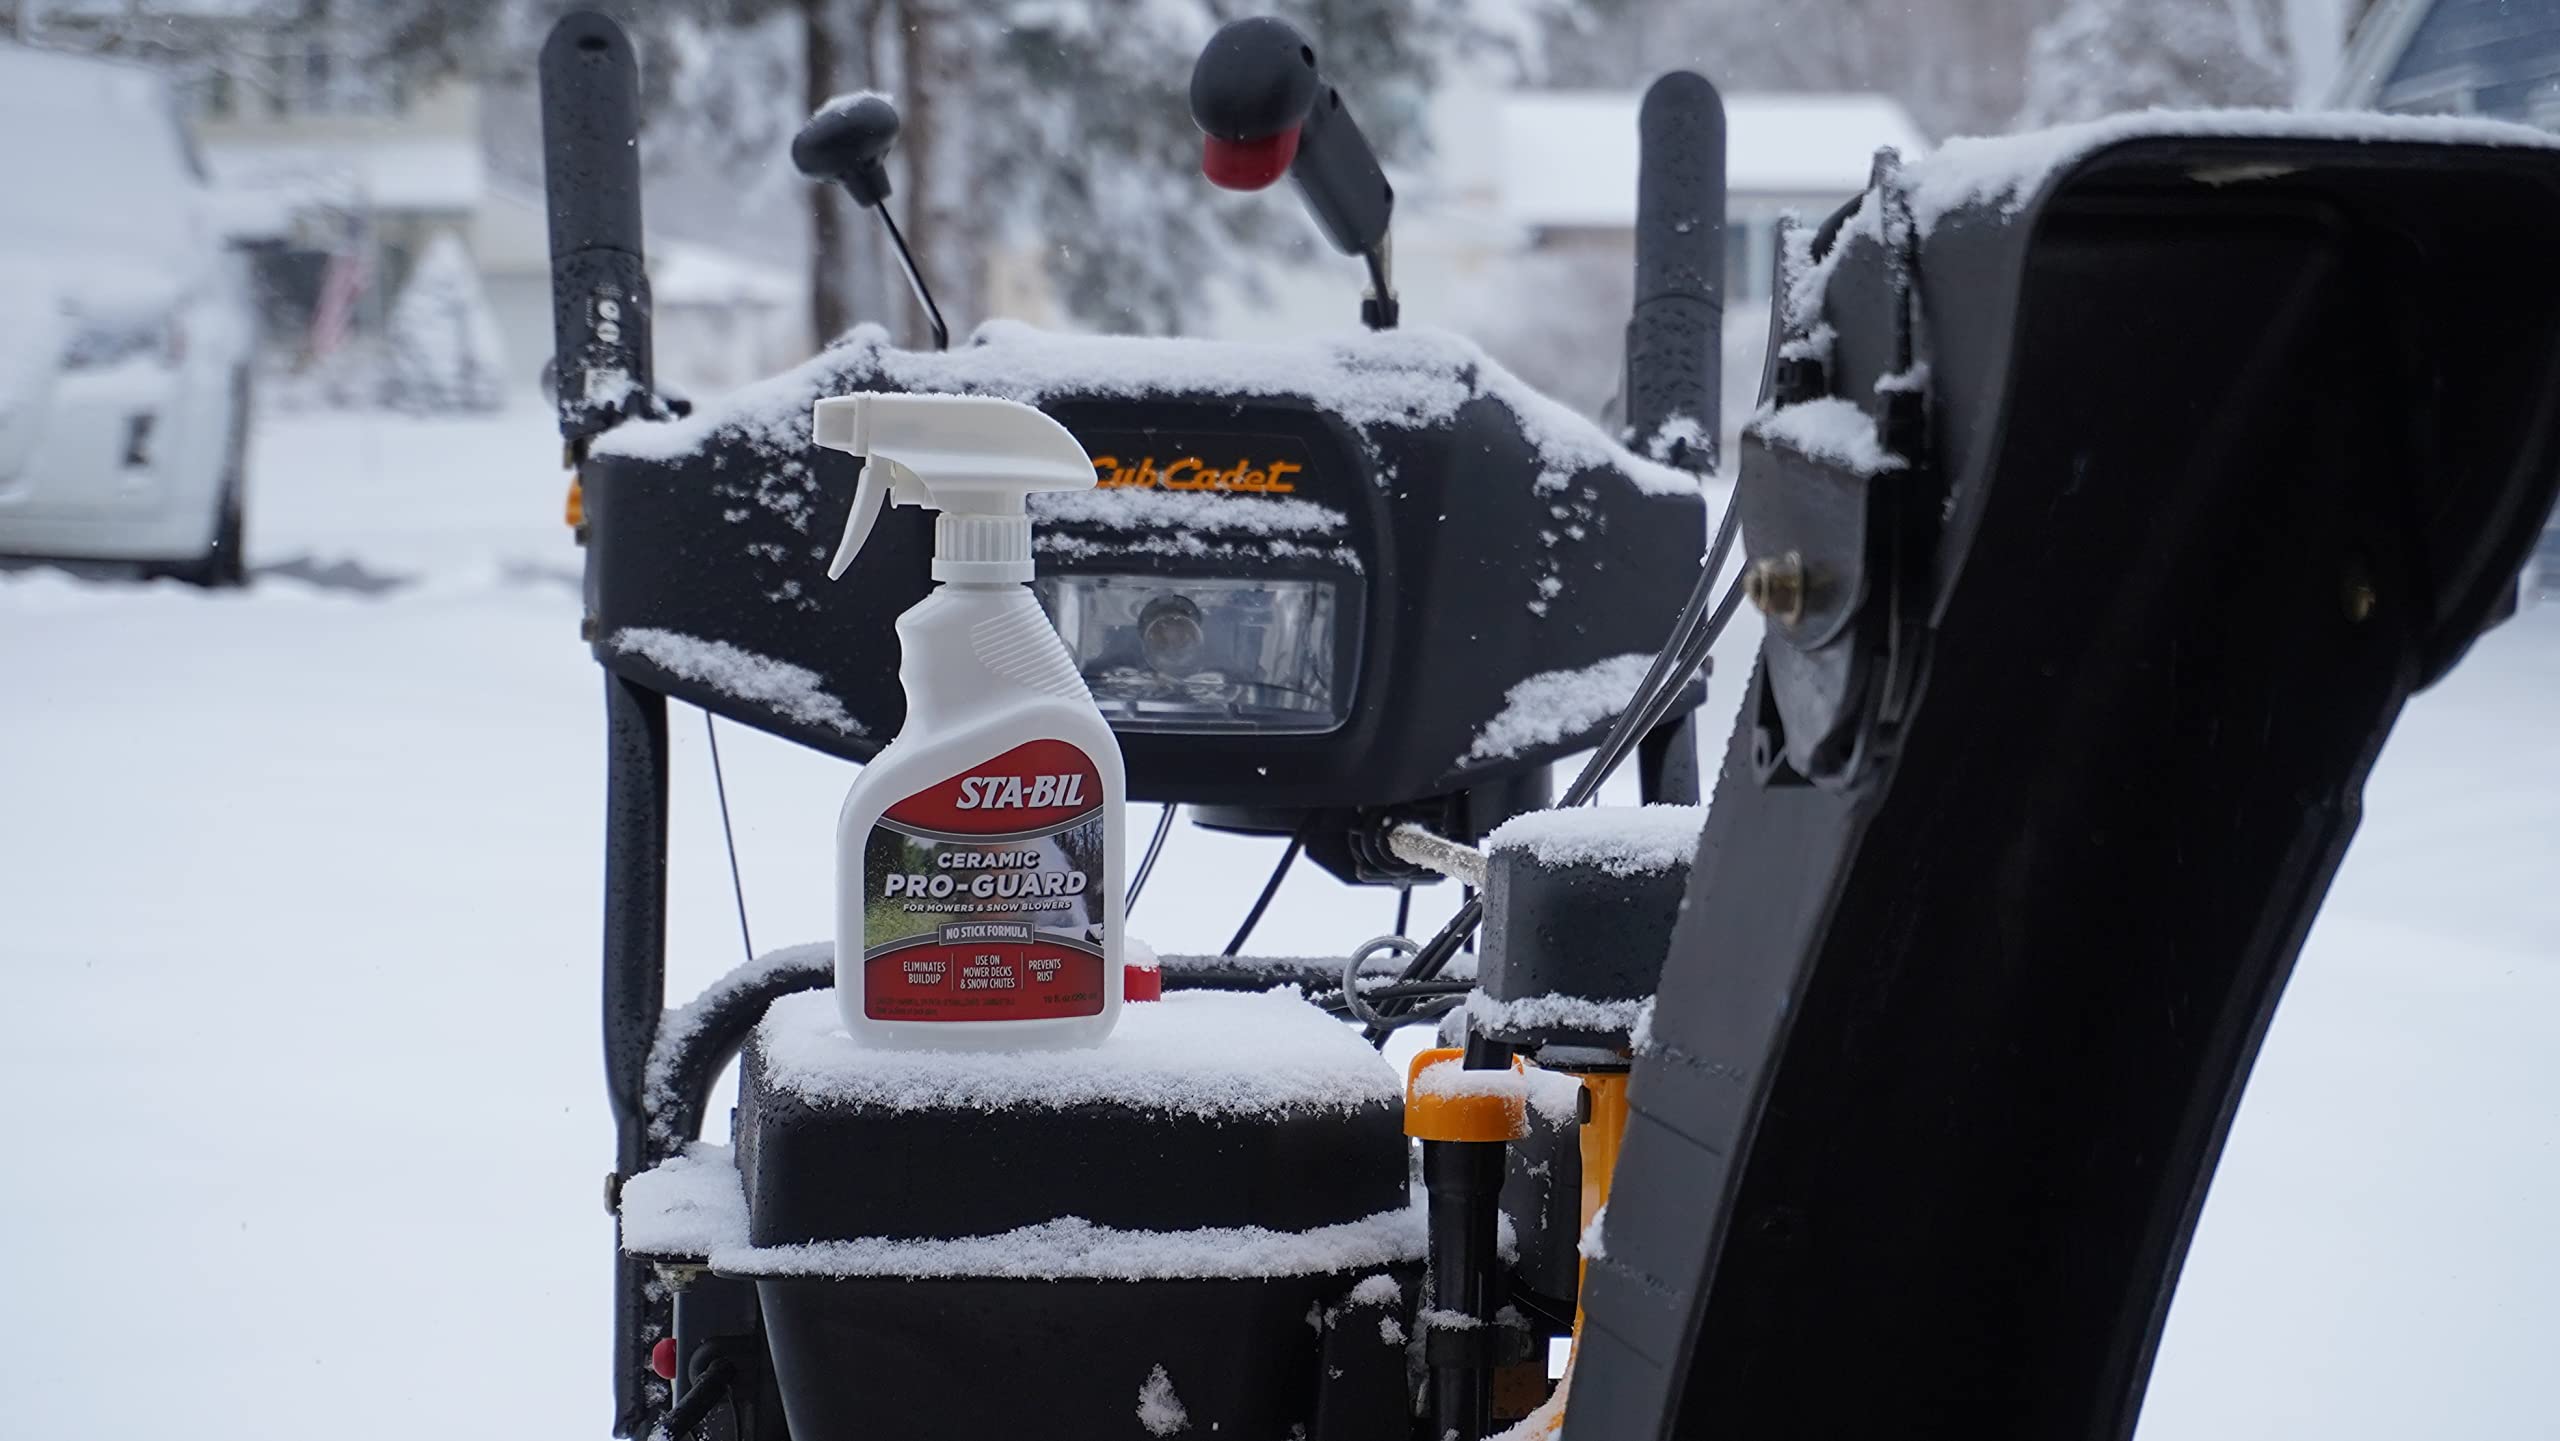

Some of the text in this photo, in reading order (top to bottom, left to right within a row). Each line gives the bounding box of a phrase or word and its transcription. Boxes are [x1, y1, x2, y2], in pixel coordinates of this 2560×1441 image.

[1163, 457, 1302, 493] Cadet
[955, 774, 1084, 810] STA-BIL
[937, 851, 1040, 868] CERAMIC
[884, 871, 1087, 899] PRO-GUARD
[903, 901, 1072, 913] FOR MOWERS & SNOW BLOWERS
[946, 925, 1028, 940] NO STICK FORMULA
[975, 955, 1000, 966] USE ON
[1028, 958, 1062, 971] PREVENTS
[903, 961, 946, 973] ELIMINATES
[963, 966, 1012, 977] MOWER DECKS
[908, 973, 941, 984] BUILDUP
[1036, 971, 1053, 982] RUST
[960, 978, 1015, 990] & SNOW CHUTES
